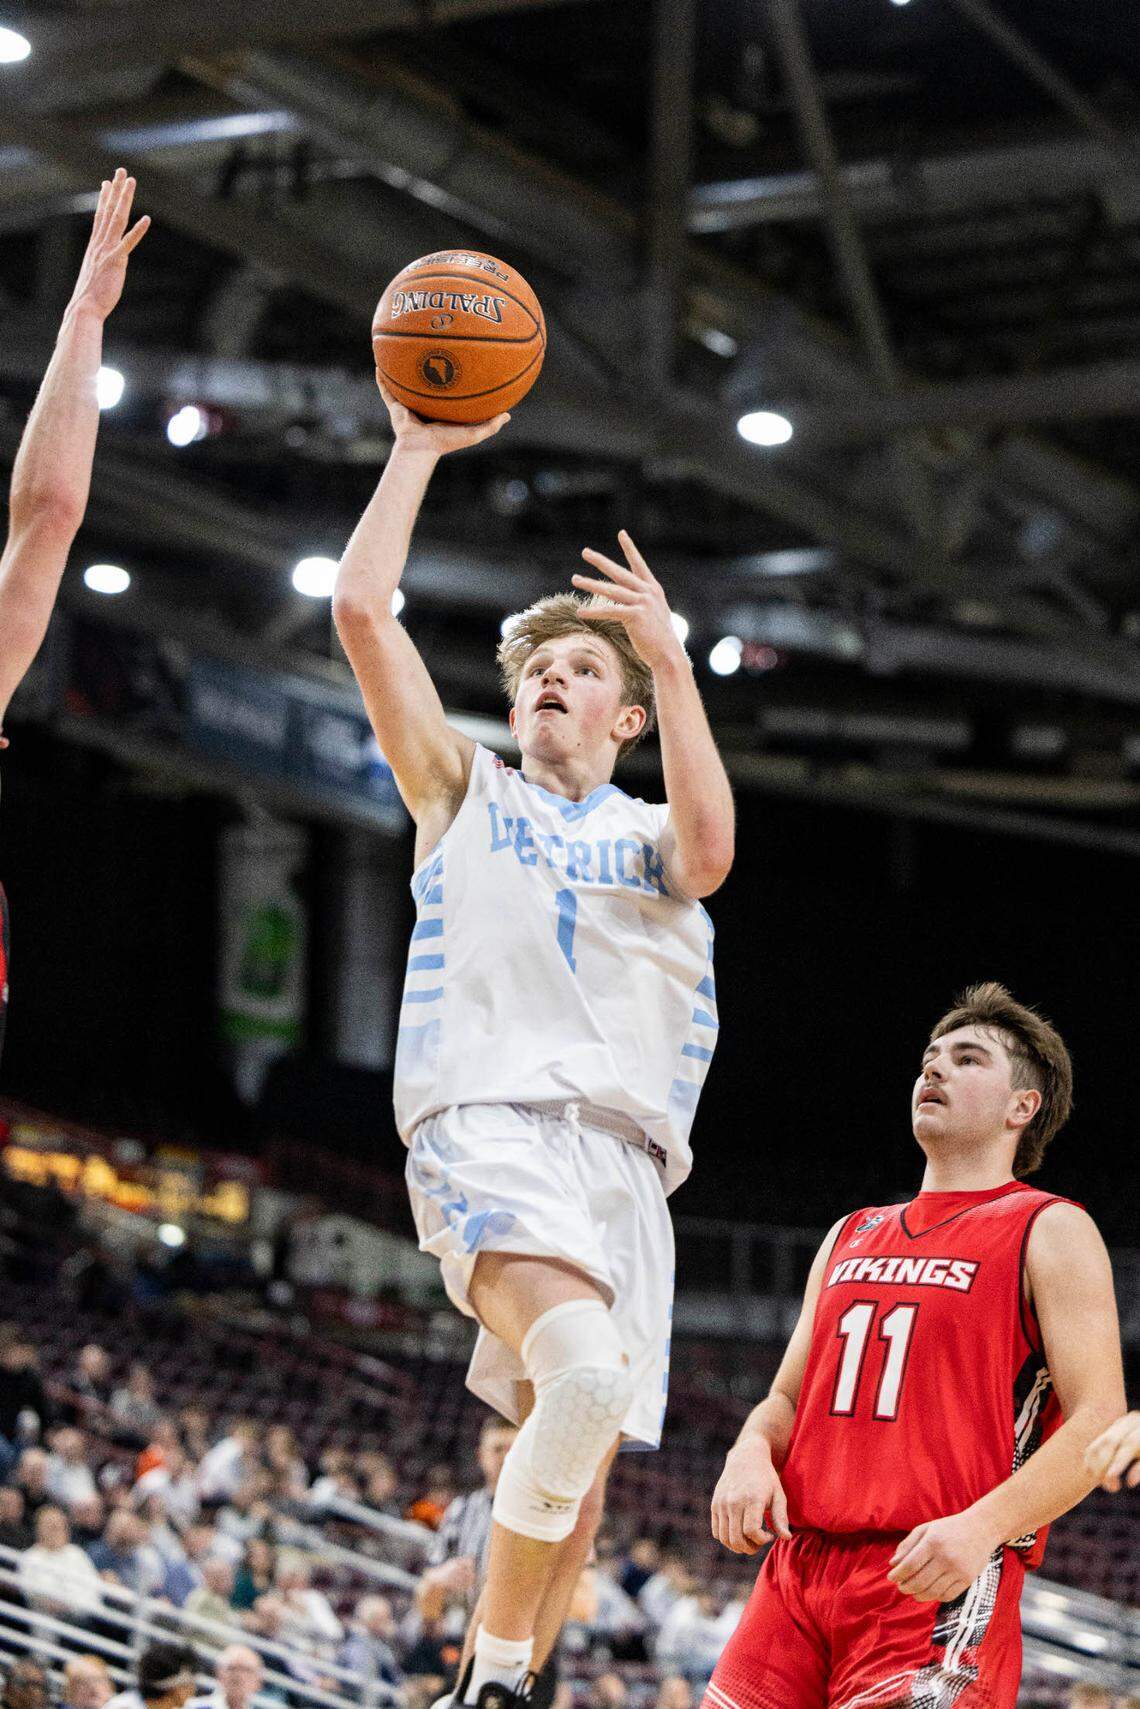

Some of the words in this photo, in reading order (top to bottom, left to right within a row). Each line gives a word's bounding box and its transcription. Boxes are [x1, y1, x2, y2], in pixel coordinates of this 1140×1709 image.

[391, 290, 507, 324] SPALDING
[554, 887, 578, 975] 1
[827, 1255, 981, 1294] VIKINGS
[829, 1299, 920, 1421] 11
